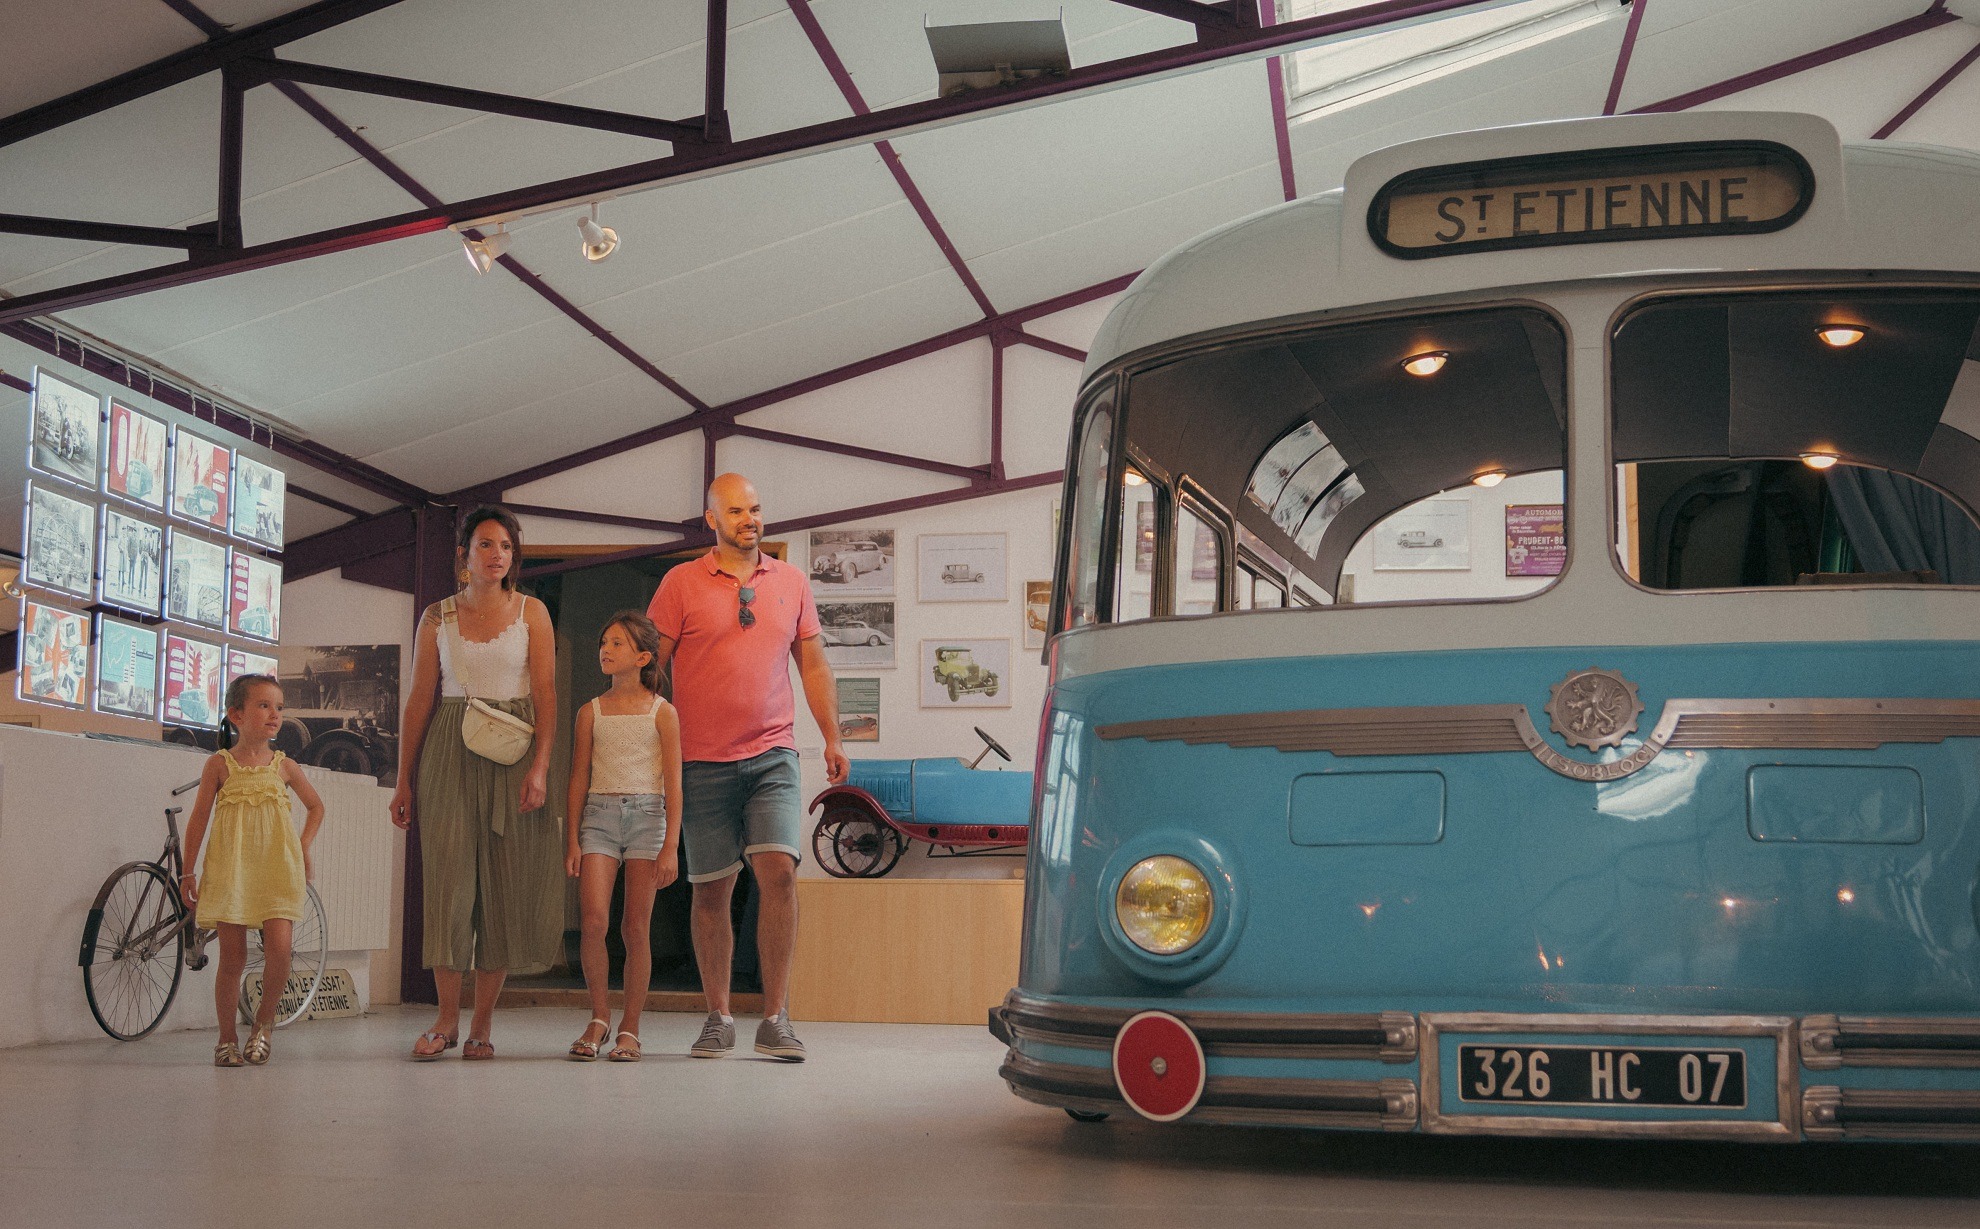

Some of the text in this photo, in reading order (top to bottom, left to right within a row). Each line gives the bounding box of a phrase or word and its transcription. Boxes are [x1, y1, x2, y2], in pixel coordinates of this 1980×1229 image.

[1512, 176, 1749, 237] ETIENNE
[1474, 1049, 1730, 1103] 326 HC 07
